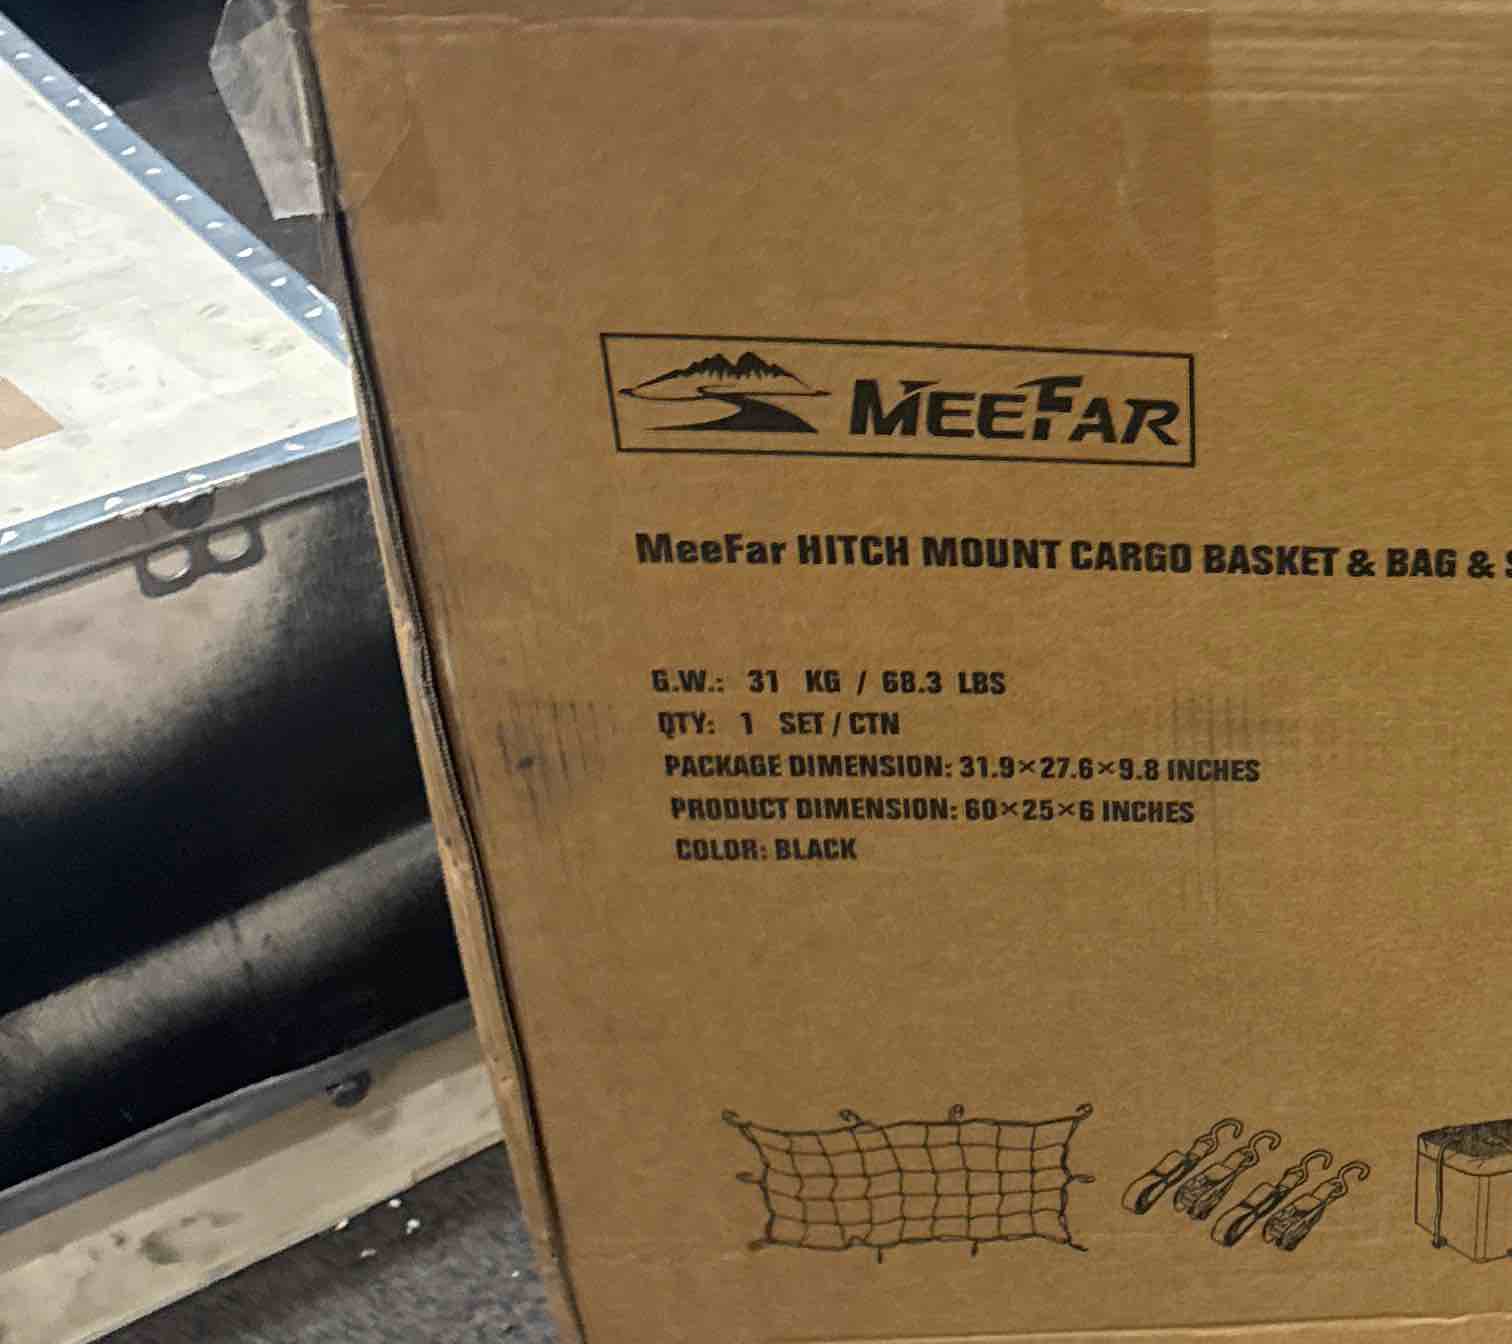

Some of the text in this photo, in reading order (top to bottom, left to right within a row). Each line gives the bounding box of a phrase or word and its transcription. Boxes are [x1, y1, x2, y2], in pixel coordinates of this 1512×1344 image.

[635, 532, 786, 566] MeeFar
[797, 535, 909, 569] HITCH
[922, 537, 1062, 570] MOUNT
[1071, 541, 1192, 574] CARGO
[1203, 543, 1339, 577] BASKET
[1346, 548, 1376, 577] &
[1386, 548, 1457, 579] BAG
[1467, 550, 1496, 579] &
[652, 670, 1006, 696] G.W.: 31 KG / 68.3 LBS
[657, 712, 714, 738] QTY:
[741, 713, 754, 735] 1
[664, 755, 782, 777] PACKAGE
[789, 755, 953, 778] DIMENSION:
[1168, 759, 1261, 783] INCHES
[671, 798, 787, 819] PRODUCT
[796, 798, 959, 820] DIMENSION:
[1103, 800, 1195, 824] INCHES
[676, 838, 857, 861] COLOR: BLACK
